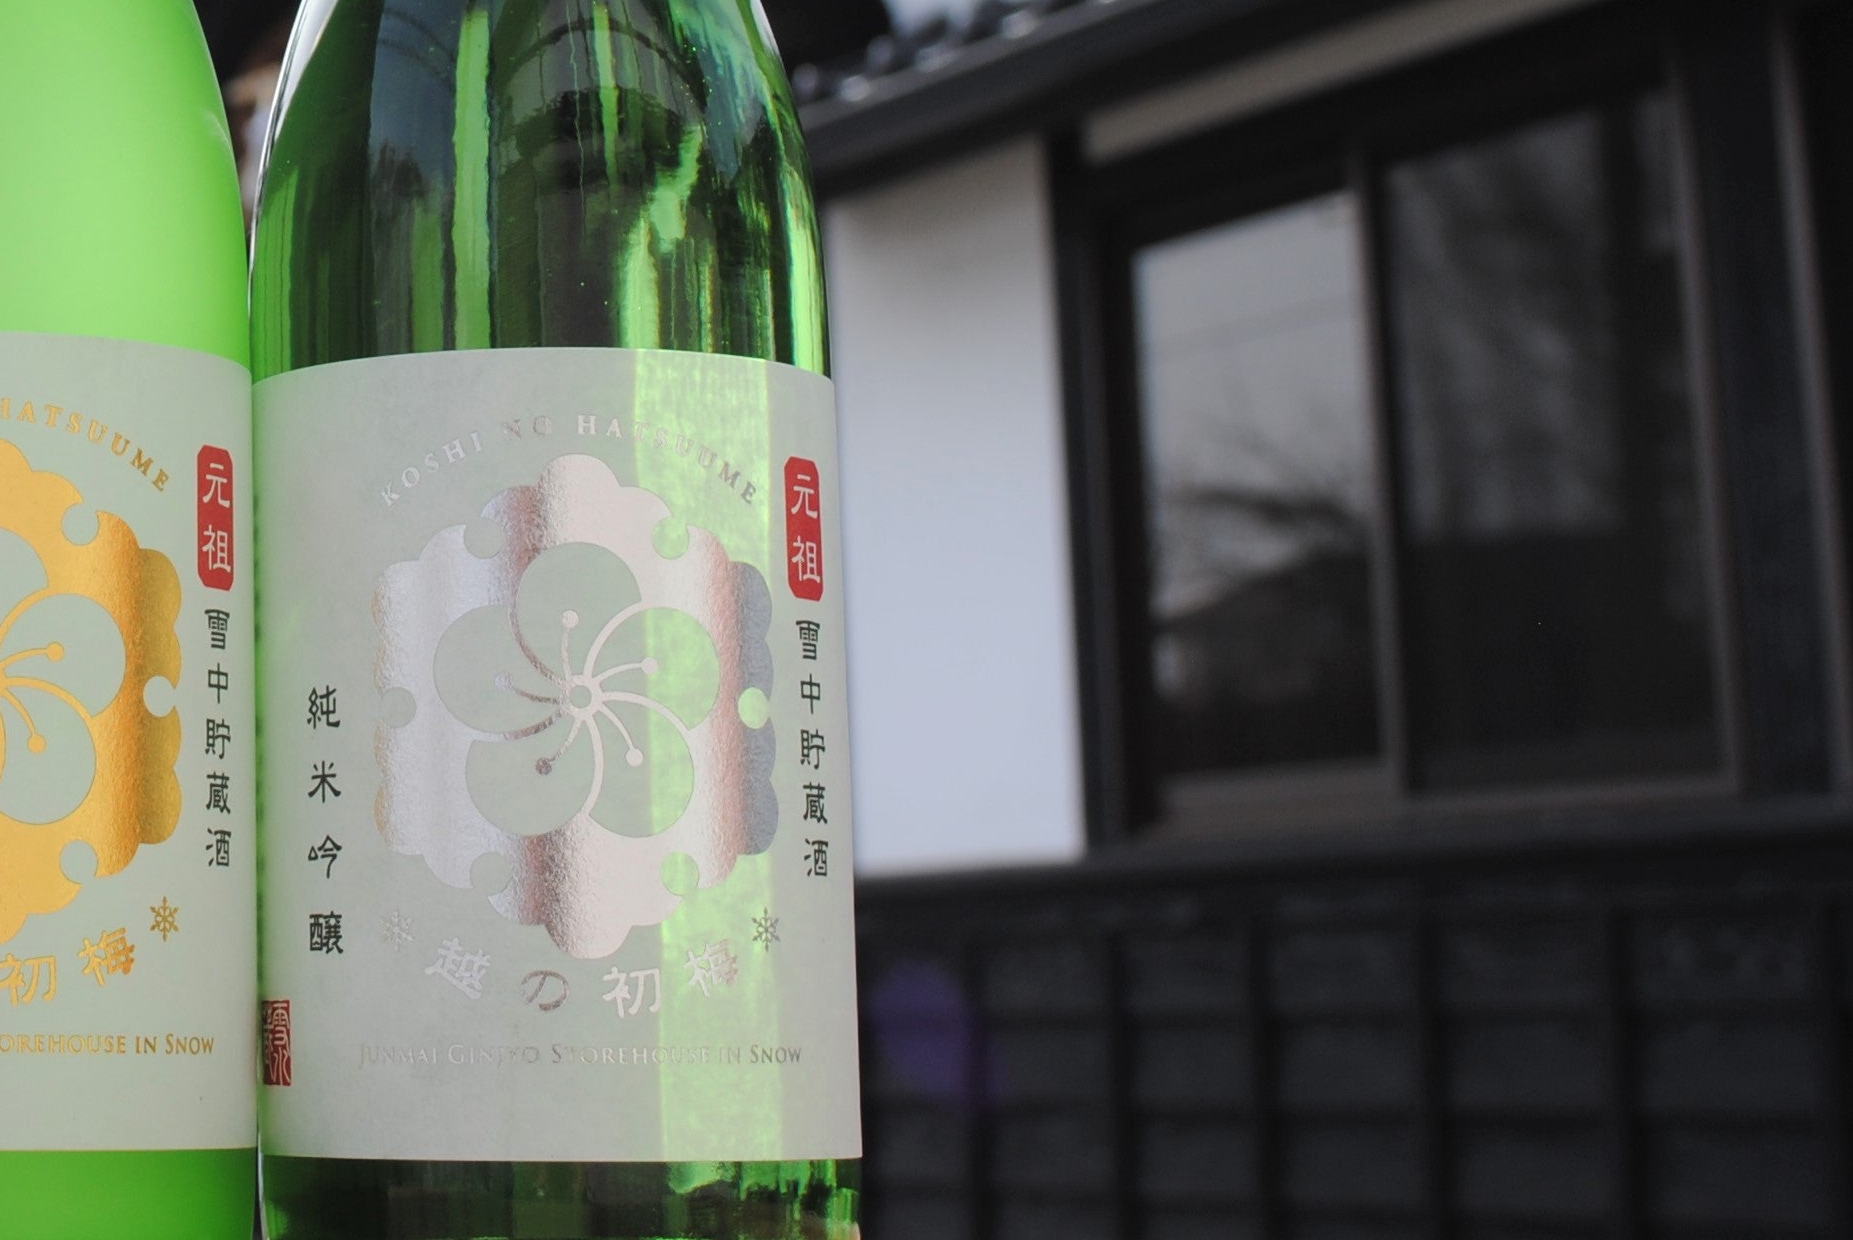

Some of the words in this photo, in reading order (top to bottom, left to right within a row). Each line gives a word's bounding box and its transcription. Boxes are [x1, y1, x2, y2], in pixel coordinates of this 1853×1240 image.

[379, 431, 484, 508] KOSHI
[501, 415, 553, 440] NO
[576, 413, 758, 504] HATSUUME
[201, 460, 234, 576] 元祖
[789, 473, 822, 585] 元祖
[204, 607, 233, 869] 雪中貯蔵酒
[795, 619, 829, 878] 雪中貯蔵酒
[306, 686, 344, 956] 純米吟醸
[424, 937, 740, 1019] 越の初梅
[135, 1035, 157, 1054] IN
[165, 1033, 216, 1056] SNOW
[360, 1045, 438, 1069] JUNMAI
[449, 1044, 540, 1073] GINJYO
[551, 1044, 711, 1064] STOREHOUSE
[720, 1048, 741, 1064] IN
[750, 1044, 803, 1064] SNOW
